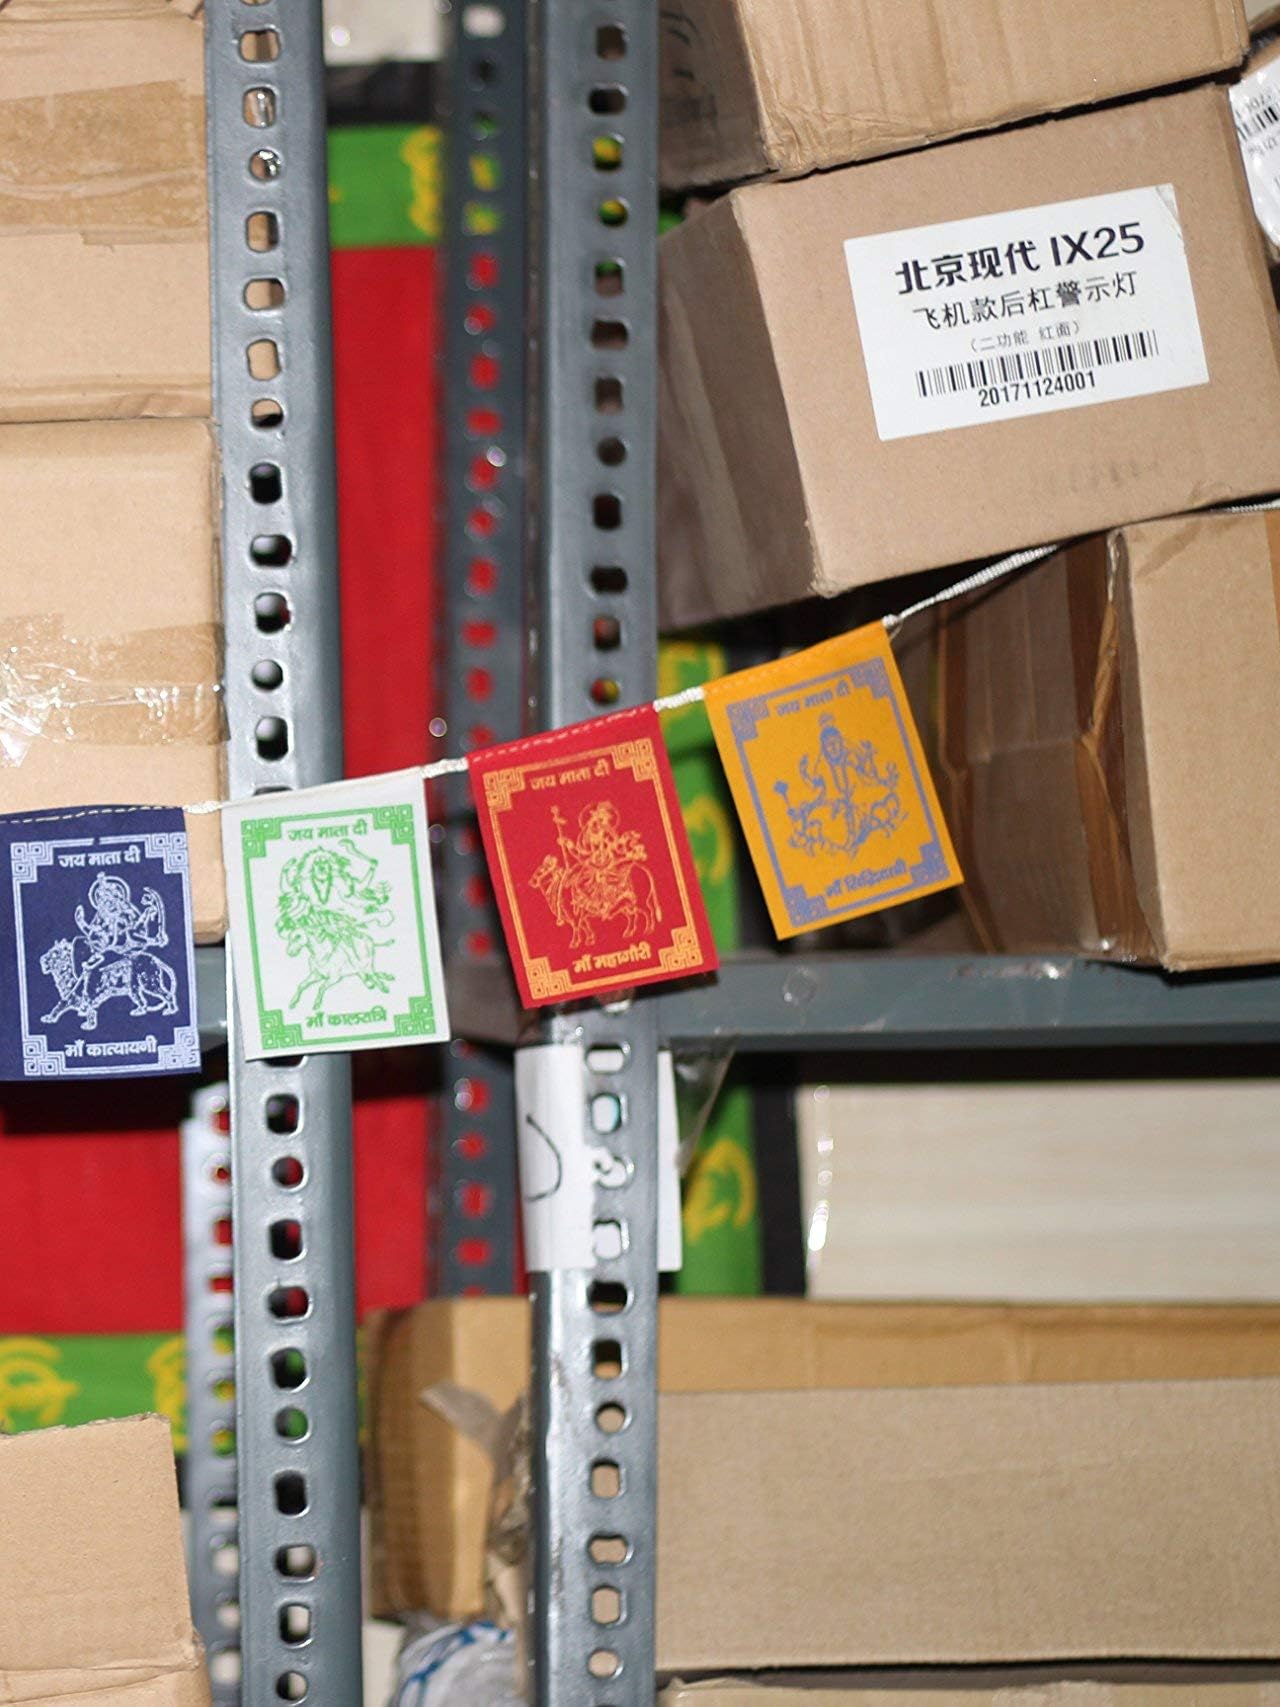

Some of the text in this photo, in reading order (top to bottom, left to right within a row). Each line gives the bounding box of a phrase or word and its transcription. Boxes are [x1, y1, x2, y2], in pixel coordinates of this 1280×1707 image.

[894, 221, 1144, 295] 北京现代 IX25
[912, 271, 1137, 330] 飞机款后杠警示灯
[978, 370, 1096, 408] 20171124001
[529, 757, 609, 791] जय माता दी
[287, 818, 368, 841] जय माता दी
[58, 844, 141, 868] जय माता दी
[572, 953, 592, 973] माँ
[64, 1039, 85, 1057] माँ
